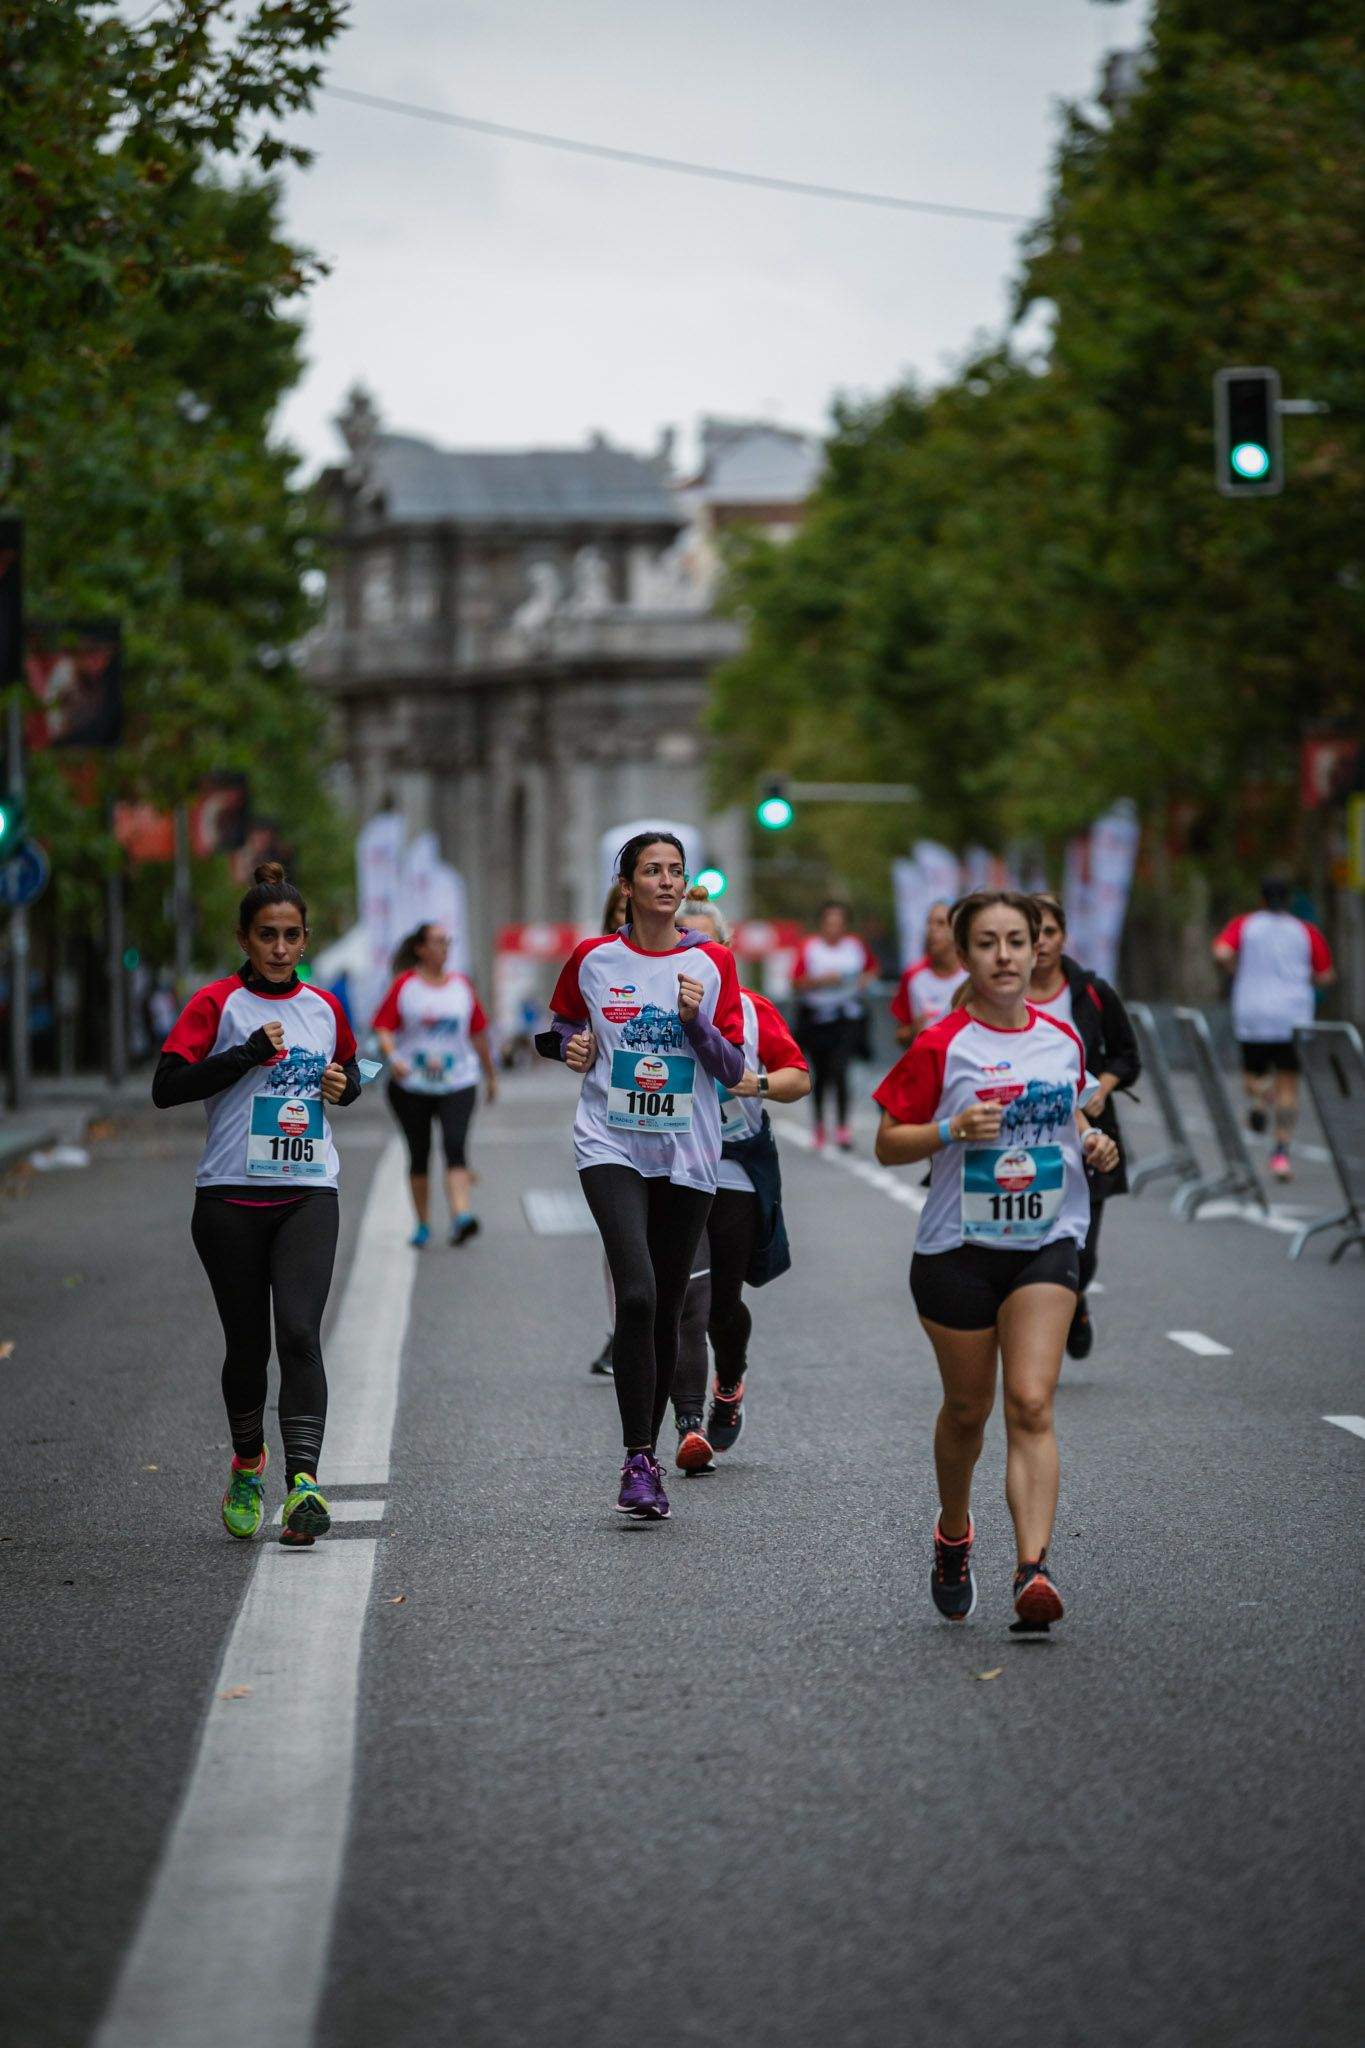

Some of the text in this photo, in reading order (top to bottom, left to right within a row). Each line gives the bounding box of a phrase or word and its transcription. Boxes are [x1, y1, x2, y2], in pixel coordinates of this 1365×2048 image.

[626, 1091, 675, 1117] 1104
[269, 1136, 314, 1163] 1105
[989, 1192, 1043, 1221] 1116
